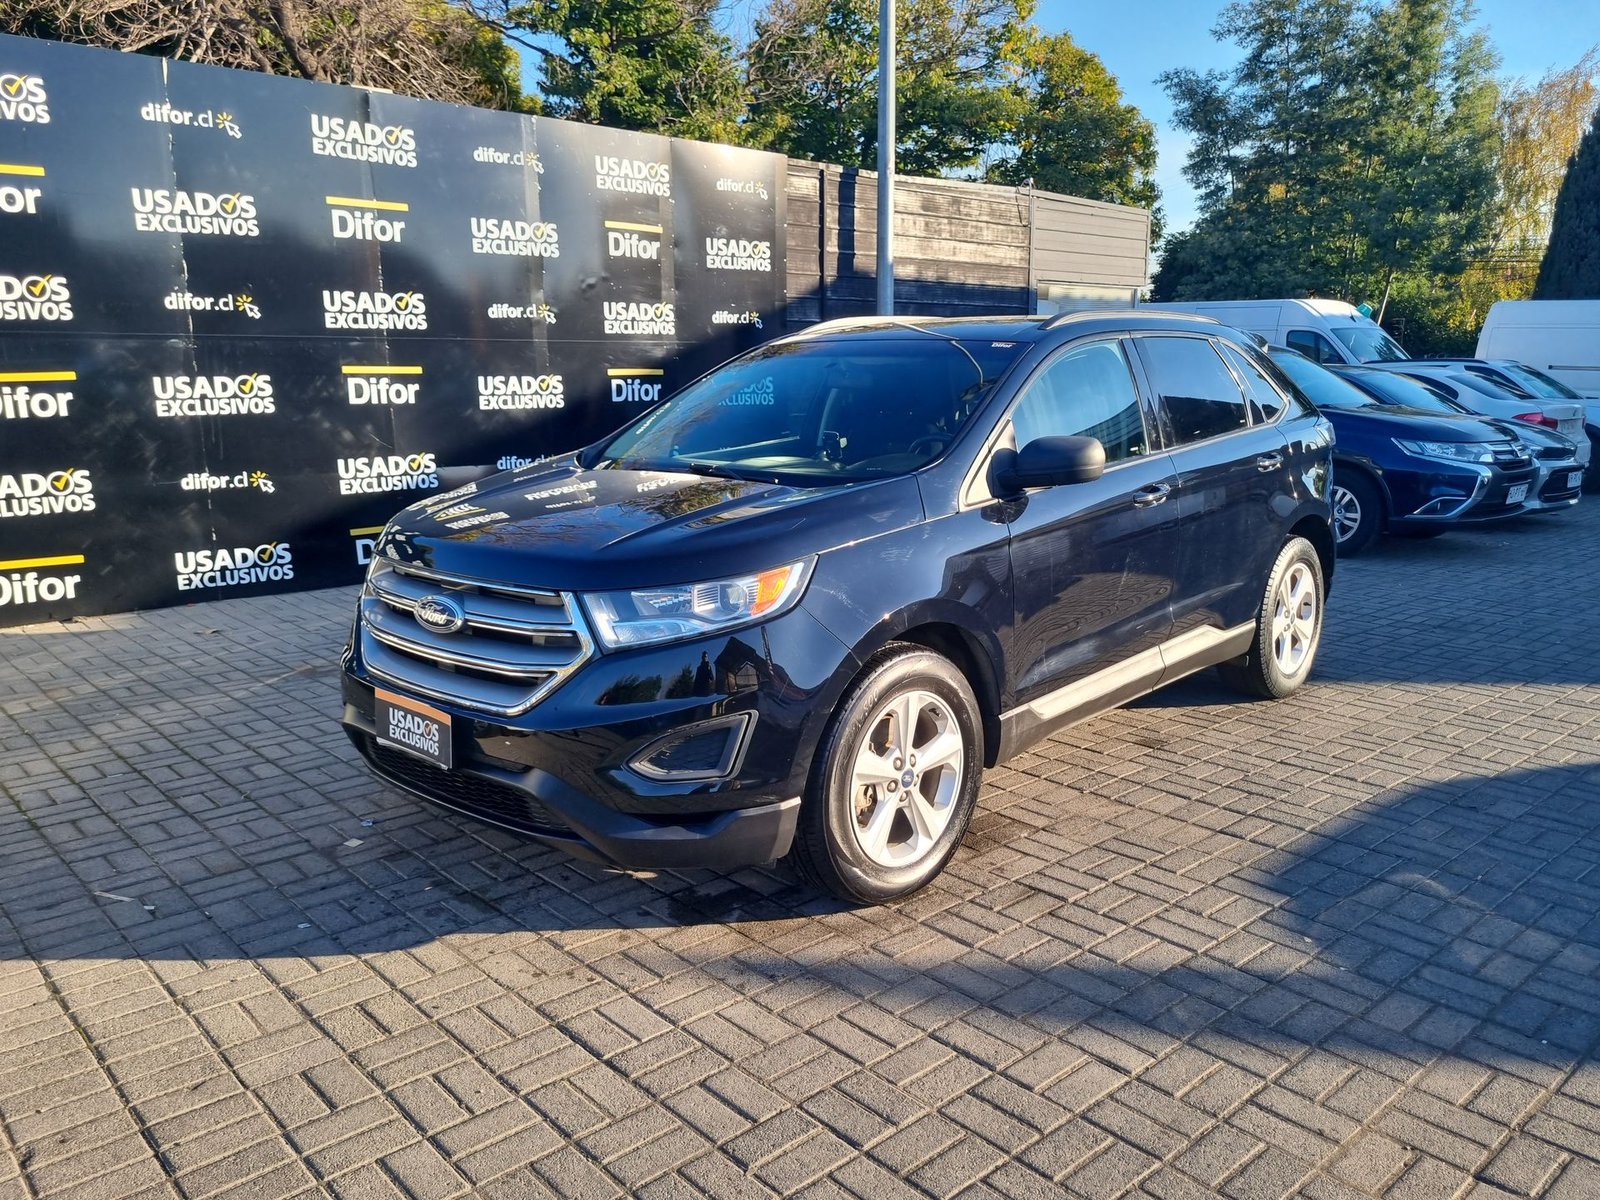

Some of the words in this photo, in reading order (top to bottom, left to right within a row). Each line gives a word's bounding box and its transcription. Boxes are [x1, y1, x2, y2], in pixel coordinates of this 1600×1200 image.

[140, 102, 213, 128] difor.cl
[310, 114, 416, 150] USADOS
[312, 137, 417, 168] EXCLUSIVOS
[473, 146, 525, 166] difor.cl
[595, 155, 670, 183] USADOS
[596, 176, 671, 197] EXCLUSIVOS
[716, 177, 754, 193] difor.cl
[131, 187, 257, 219] USADOS
[134, 212, 259, 237] EXCLUSIVOS
[331, 209, 406, 243] Difor
[470, 217, 558, 242] USADOS
[472, 237, 560, 258] EXCLUSIVOS
[608, 231, 661, 260] Difor
[706, 237, 771, 258] USADOS
[706, 255, 771, 272] EXCLUSIVOS
[0, 275, 70, 302] DOS
[164, 292, 234, 311] difor.cl
[322, 290, 426, 315] USADOS
[487, 303, 537, 319] difor.cl
[603, 301, 675, 322] USADOS
[324, 312, 428, 330] EXCLUSIVOS
[604, 320, 675, 335] EXCLUSIVOS
[711, 310, 750, 324] difor.cl
[152, 374, 273, 401] USADOS
[347, 377, 420, 405] Difor
[477, 375, 563, 395] USADOS
[611, 378, 661, 402] Difor
[0, 386, 74, 419] ifor
[156, 397, 276, 417] EXCLUSIVOS
[479, 394, 565, 411] EXCLUSIVOS
[337, 453, 437, 480] USADOS
[0, 469, 93, 499] ADOS
[181, 471, 248, 491] difor.cl
[339, 473, 440, 495] EXCLUSIVOS
[0, 493, 96, 518] LUSIVOS
[174, 542, 292, 574] USADOS
[176, 564, 294, 591] EXCLUSIVOS
[418, 599, 448, 624] Ford
[389, 707, 439, 741] USADOS
[389, 724, 439, 755] EXCLUSIVOS
